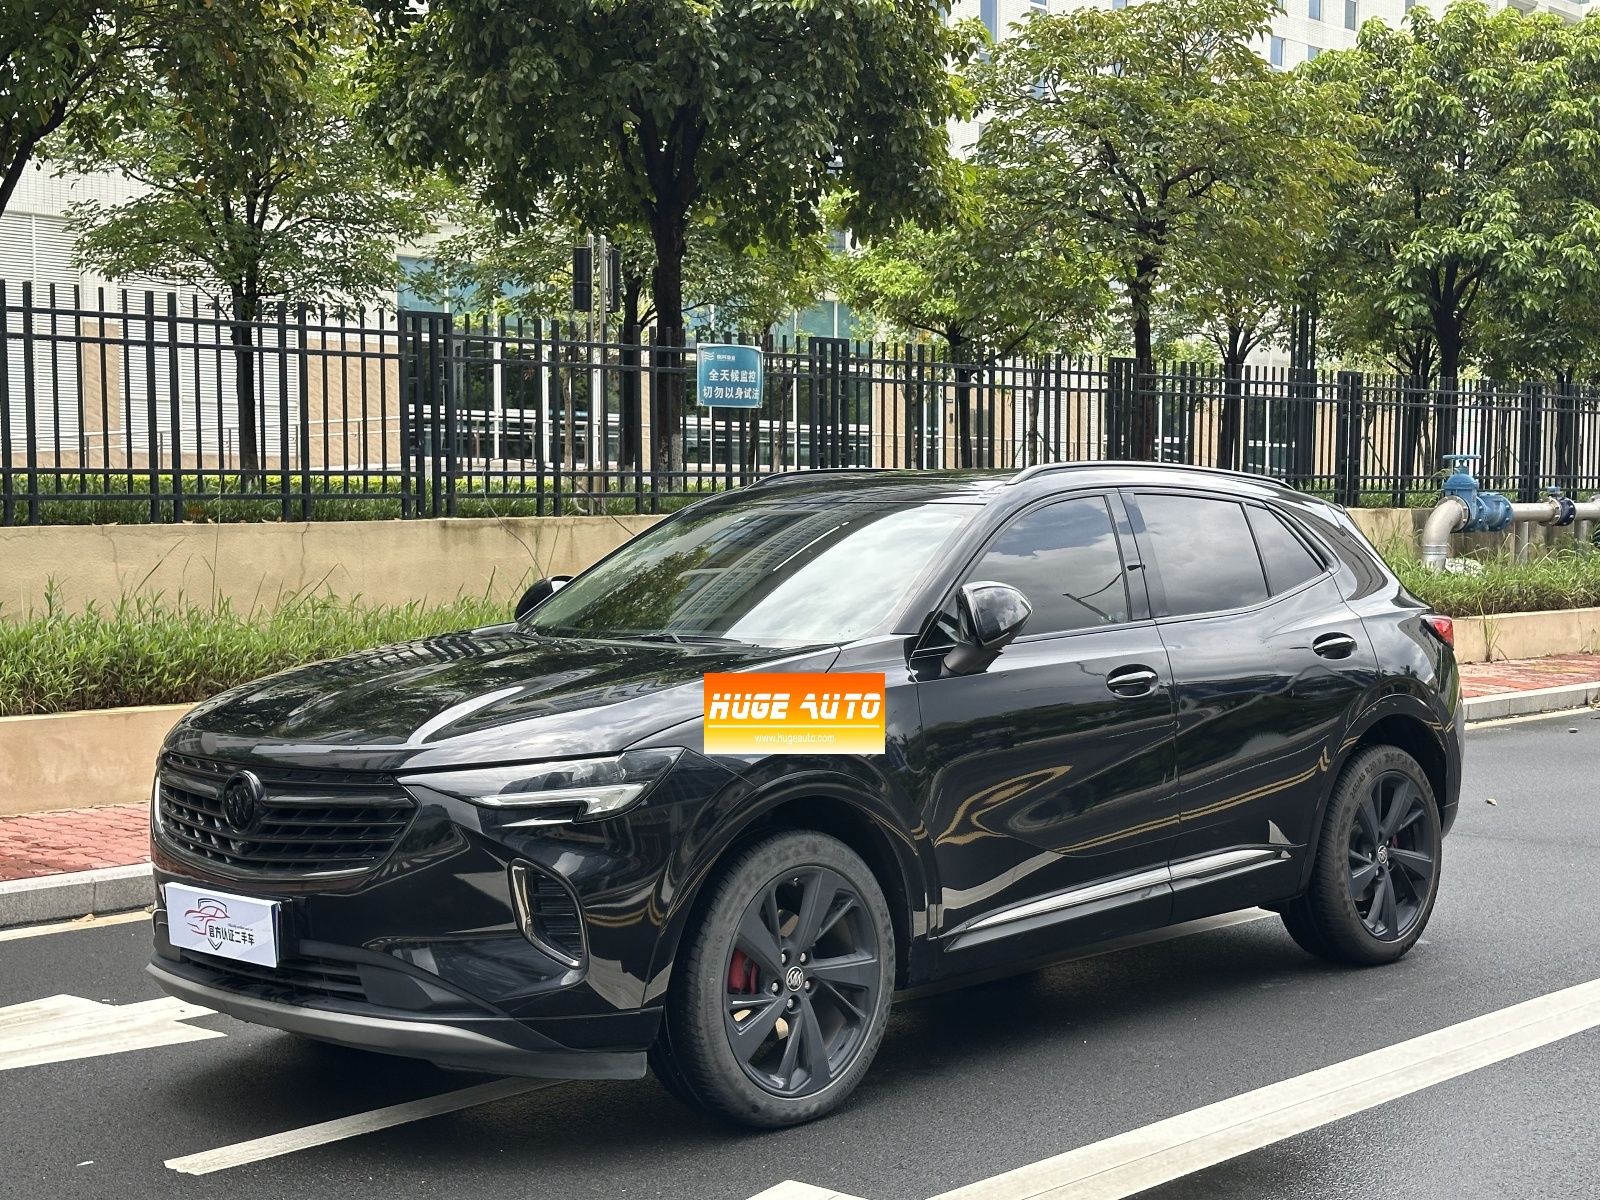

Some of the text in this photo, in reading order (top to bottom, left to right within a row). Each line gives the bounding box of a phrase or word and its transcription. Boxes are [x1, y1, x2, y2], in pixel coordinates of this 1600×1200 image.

[708, 368, 756, 382] 全天候监控
[703, 386, 759, 399] 切勿以身试法
[208, 925, 254, 946] 官方认证二手车
